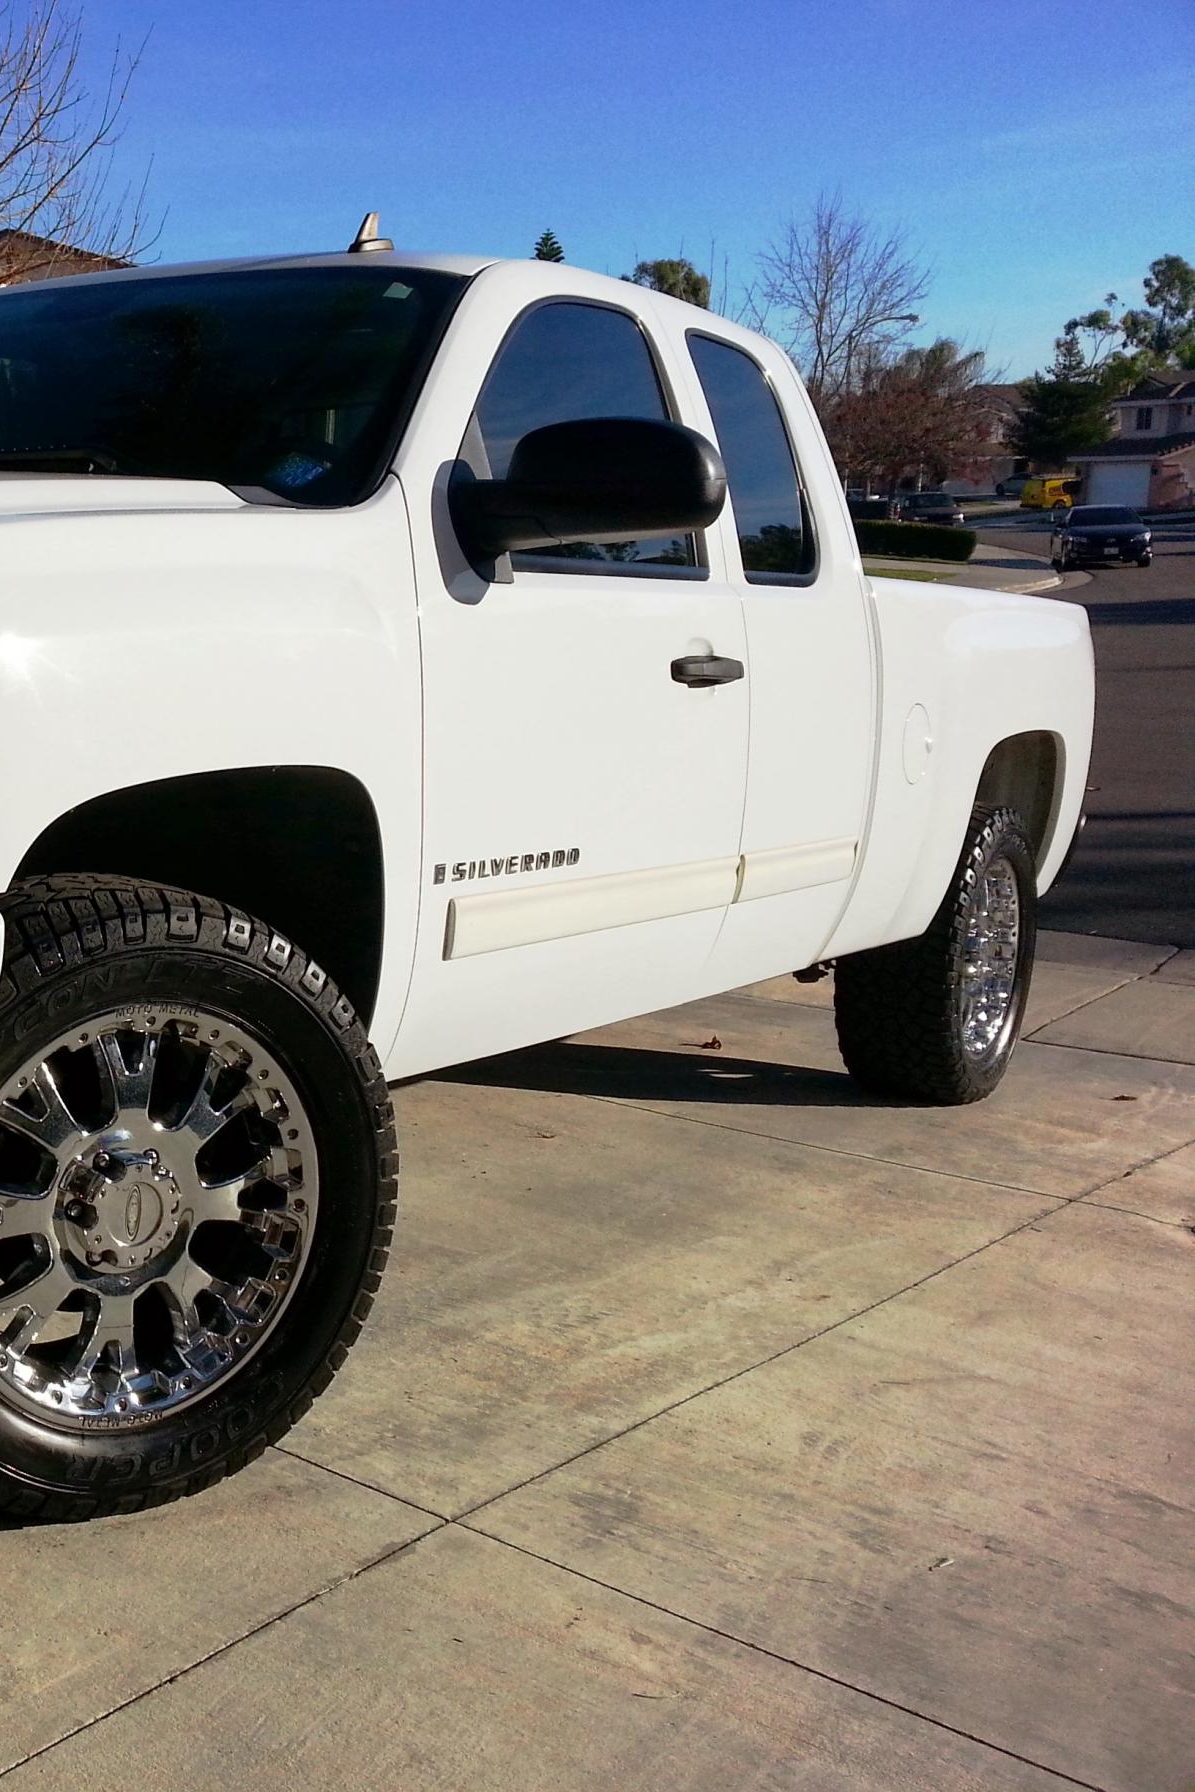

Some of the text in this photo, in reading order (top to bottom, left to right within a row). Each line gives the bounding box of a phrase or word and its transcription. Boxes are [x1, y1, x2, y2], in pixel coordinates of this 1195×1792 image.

[451, 848, 580, 882] SILVERADO
[115, 1003, 200, 1019] MOTO METAL
[78, 1415, 120, 1430] METAL
